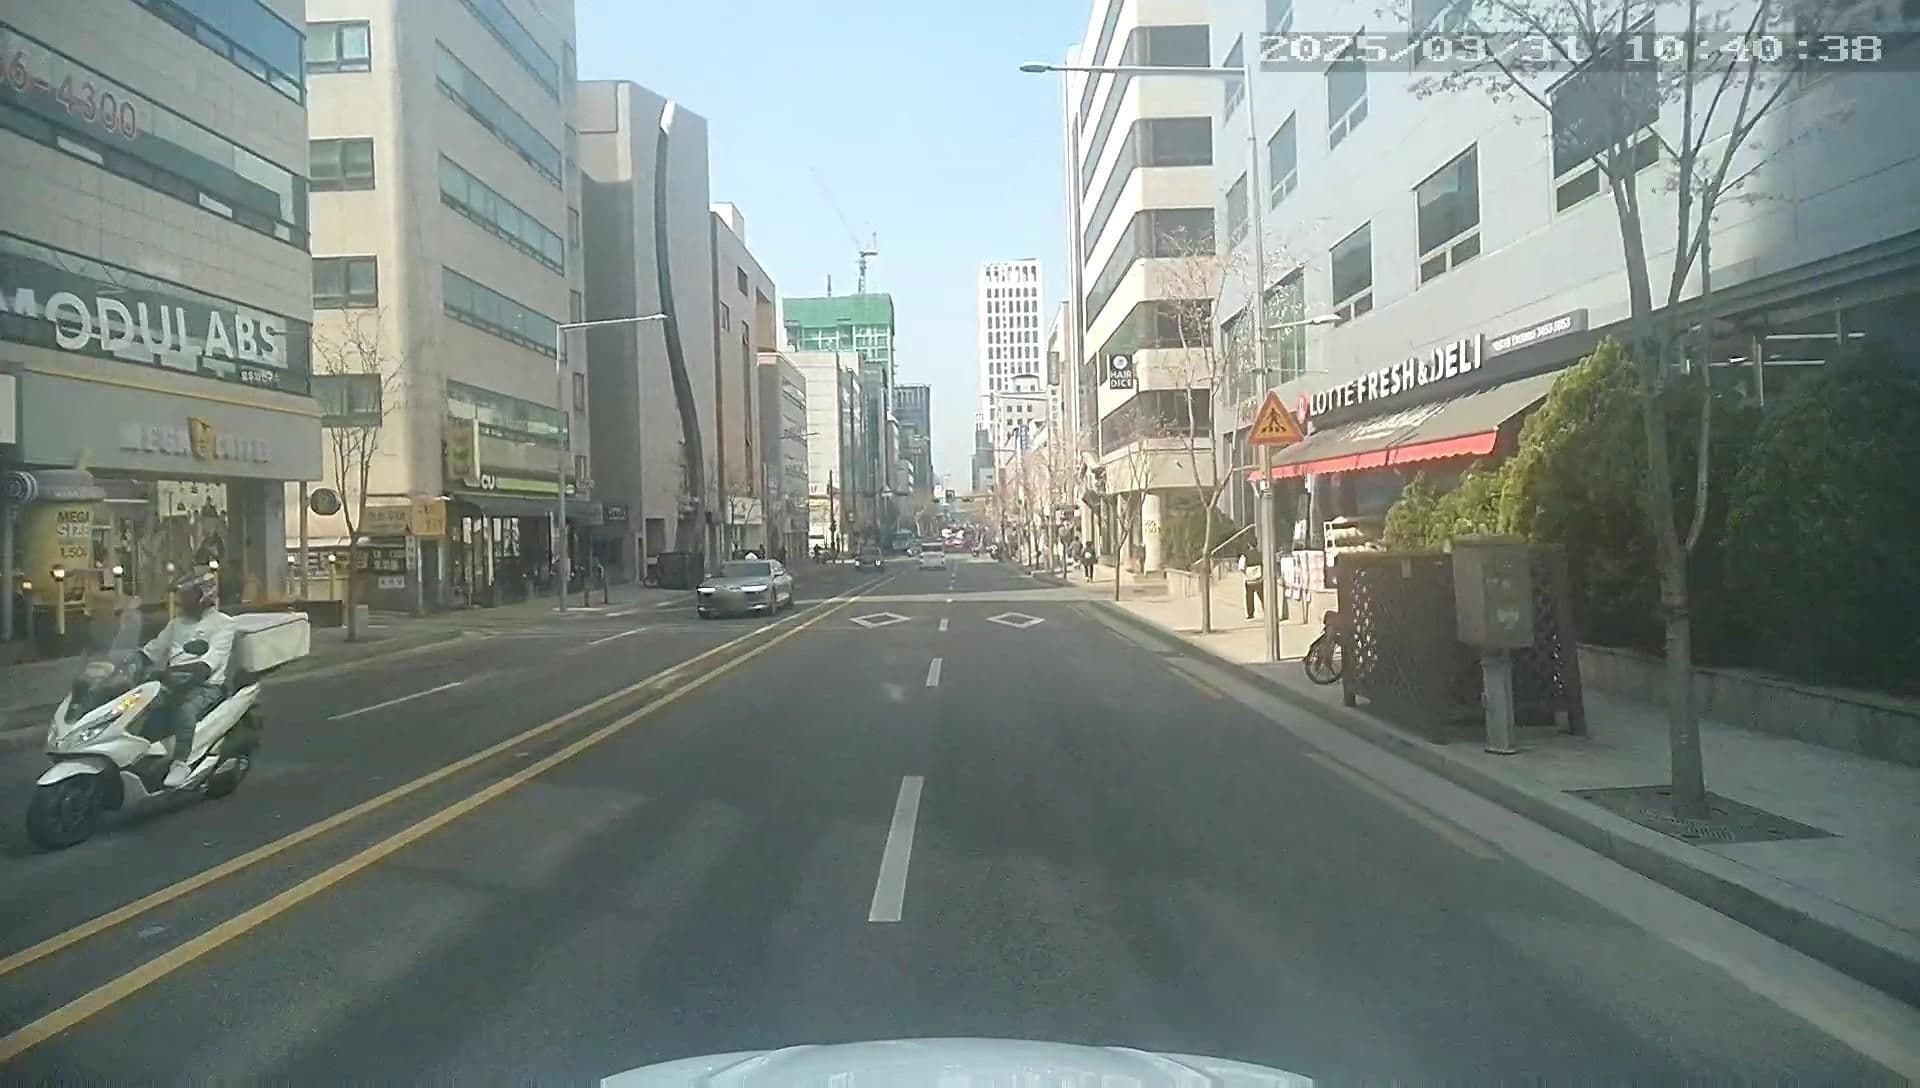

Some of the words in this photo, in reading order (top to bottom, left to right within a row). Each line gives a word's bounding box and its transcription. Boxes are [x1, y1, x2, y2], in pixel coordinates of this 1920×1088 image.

[0, 50, 137, 140] 6-4300
[1110, 369, 1133, 379] HAIR
[481, 474, 496, 490] CU
